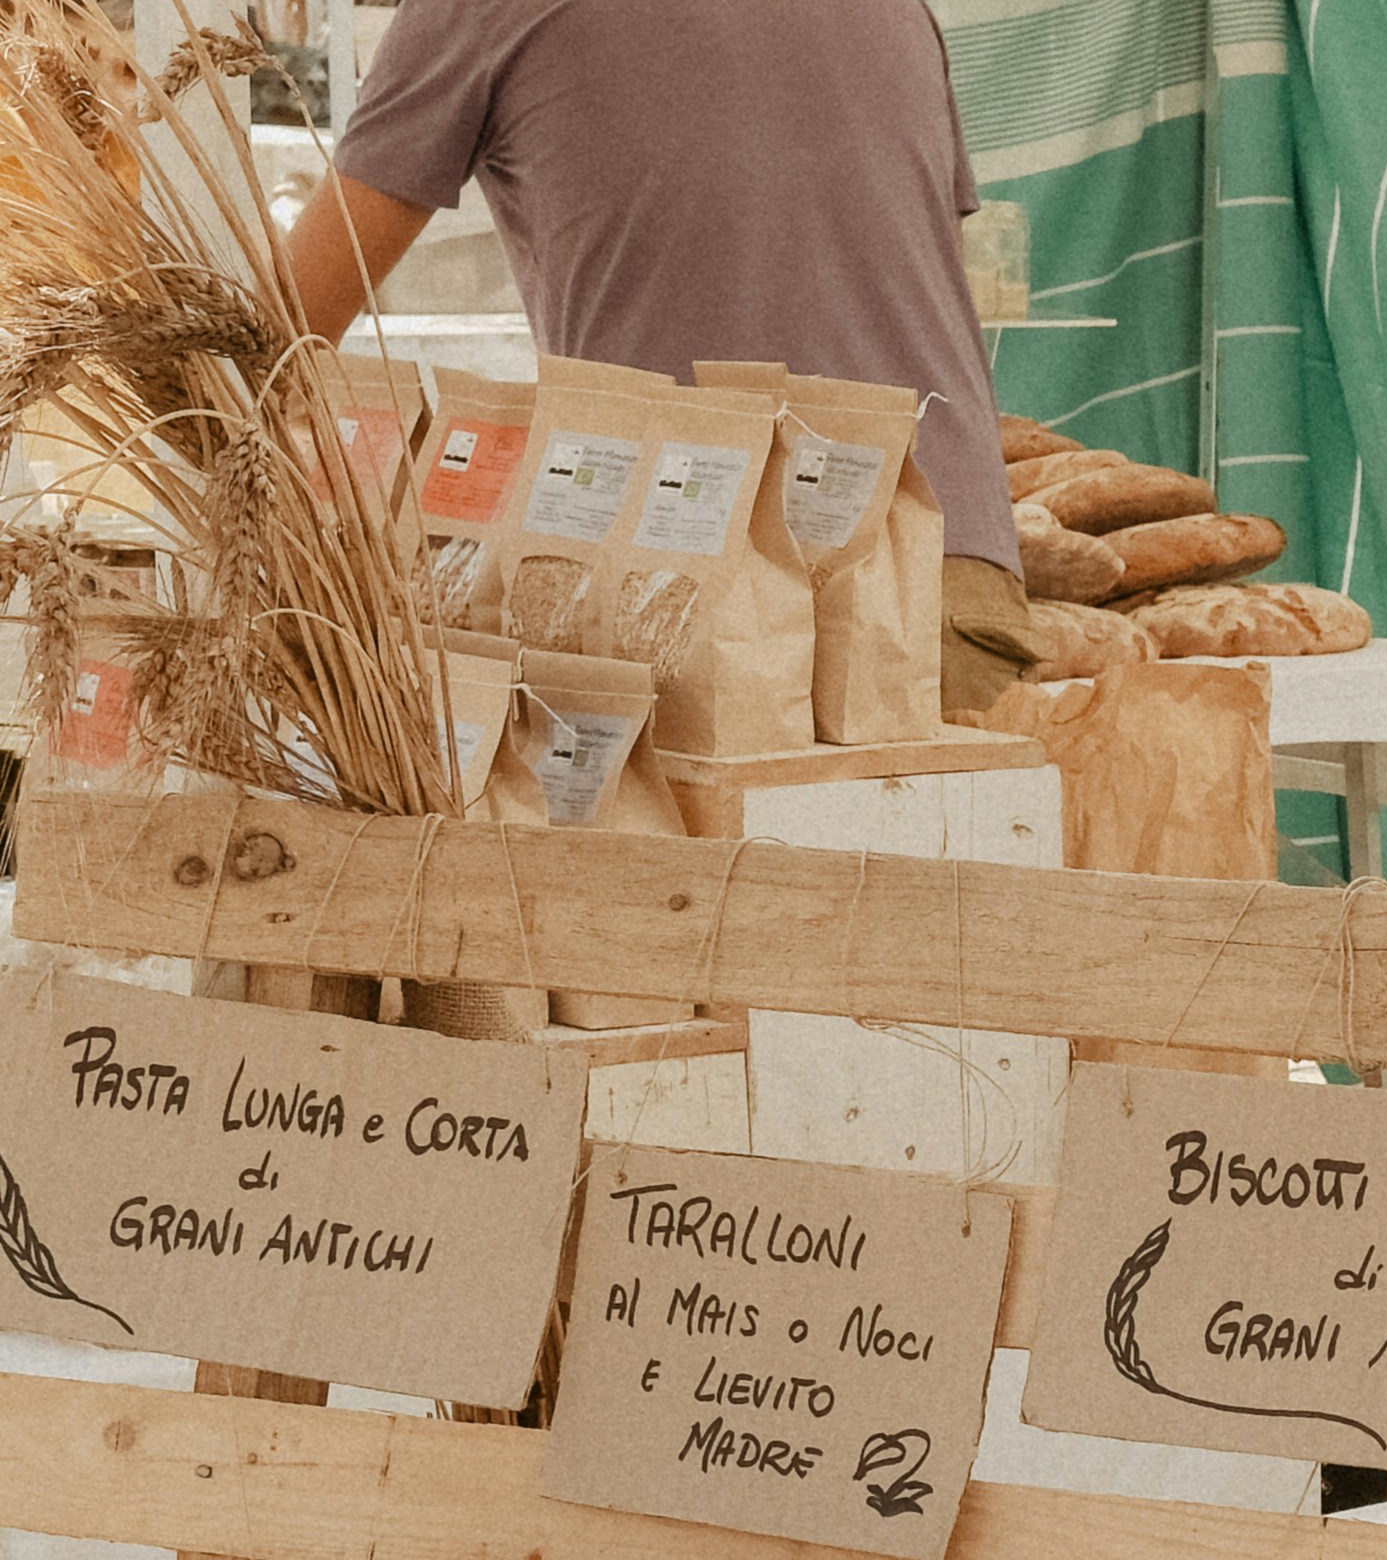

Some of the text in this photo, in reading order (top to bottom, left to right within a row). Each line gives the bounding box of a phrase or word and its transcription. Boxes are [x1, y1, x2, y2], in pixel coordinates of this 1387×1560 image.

[64, 1027, 530, 1162] PASTA LUNGA e CORTA
[238, 1151, 278, 1192] di
[1166, 1130, 1368, 1210] BISCOTTI
[110, 1198, 432, 1274] GRANI ANTICHI
[610, 1184, 865, 1270] TARALLONI
[1334, 1245, 1383, 1290] di
[668, 1286, 760, 1337] MAIS
[1205, 1300, 1341, 1359] GRANI
[695, 1357, 835, 1417] LIEVITO
[678, 1420, 822, 1479] MADRE
